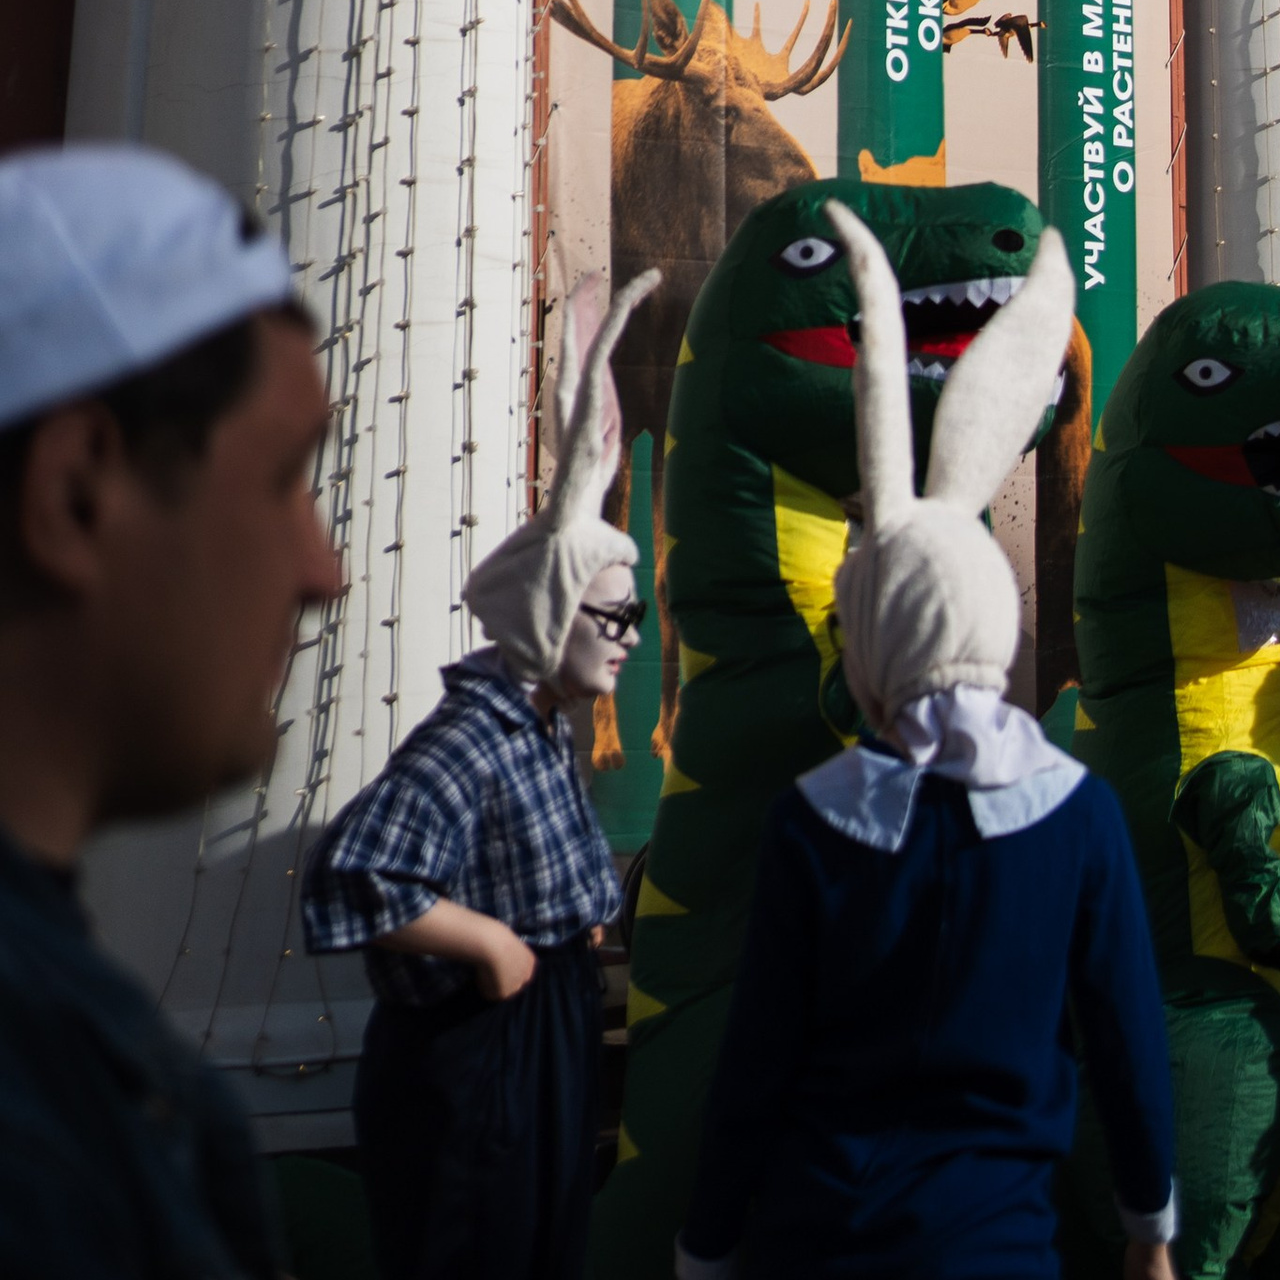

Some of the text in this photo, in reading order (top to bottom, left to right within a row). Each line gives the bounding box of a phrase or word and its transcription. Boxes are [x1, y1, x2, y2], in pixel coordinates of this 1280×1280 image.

[1083, 50, 1104, 75] В
[1078, 87, 1106, 290] УЧАСТВУЙ
[1112, 161, 1135, 193] О
